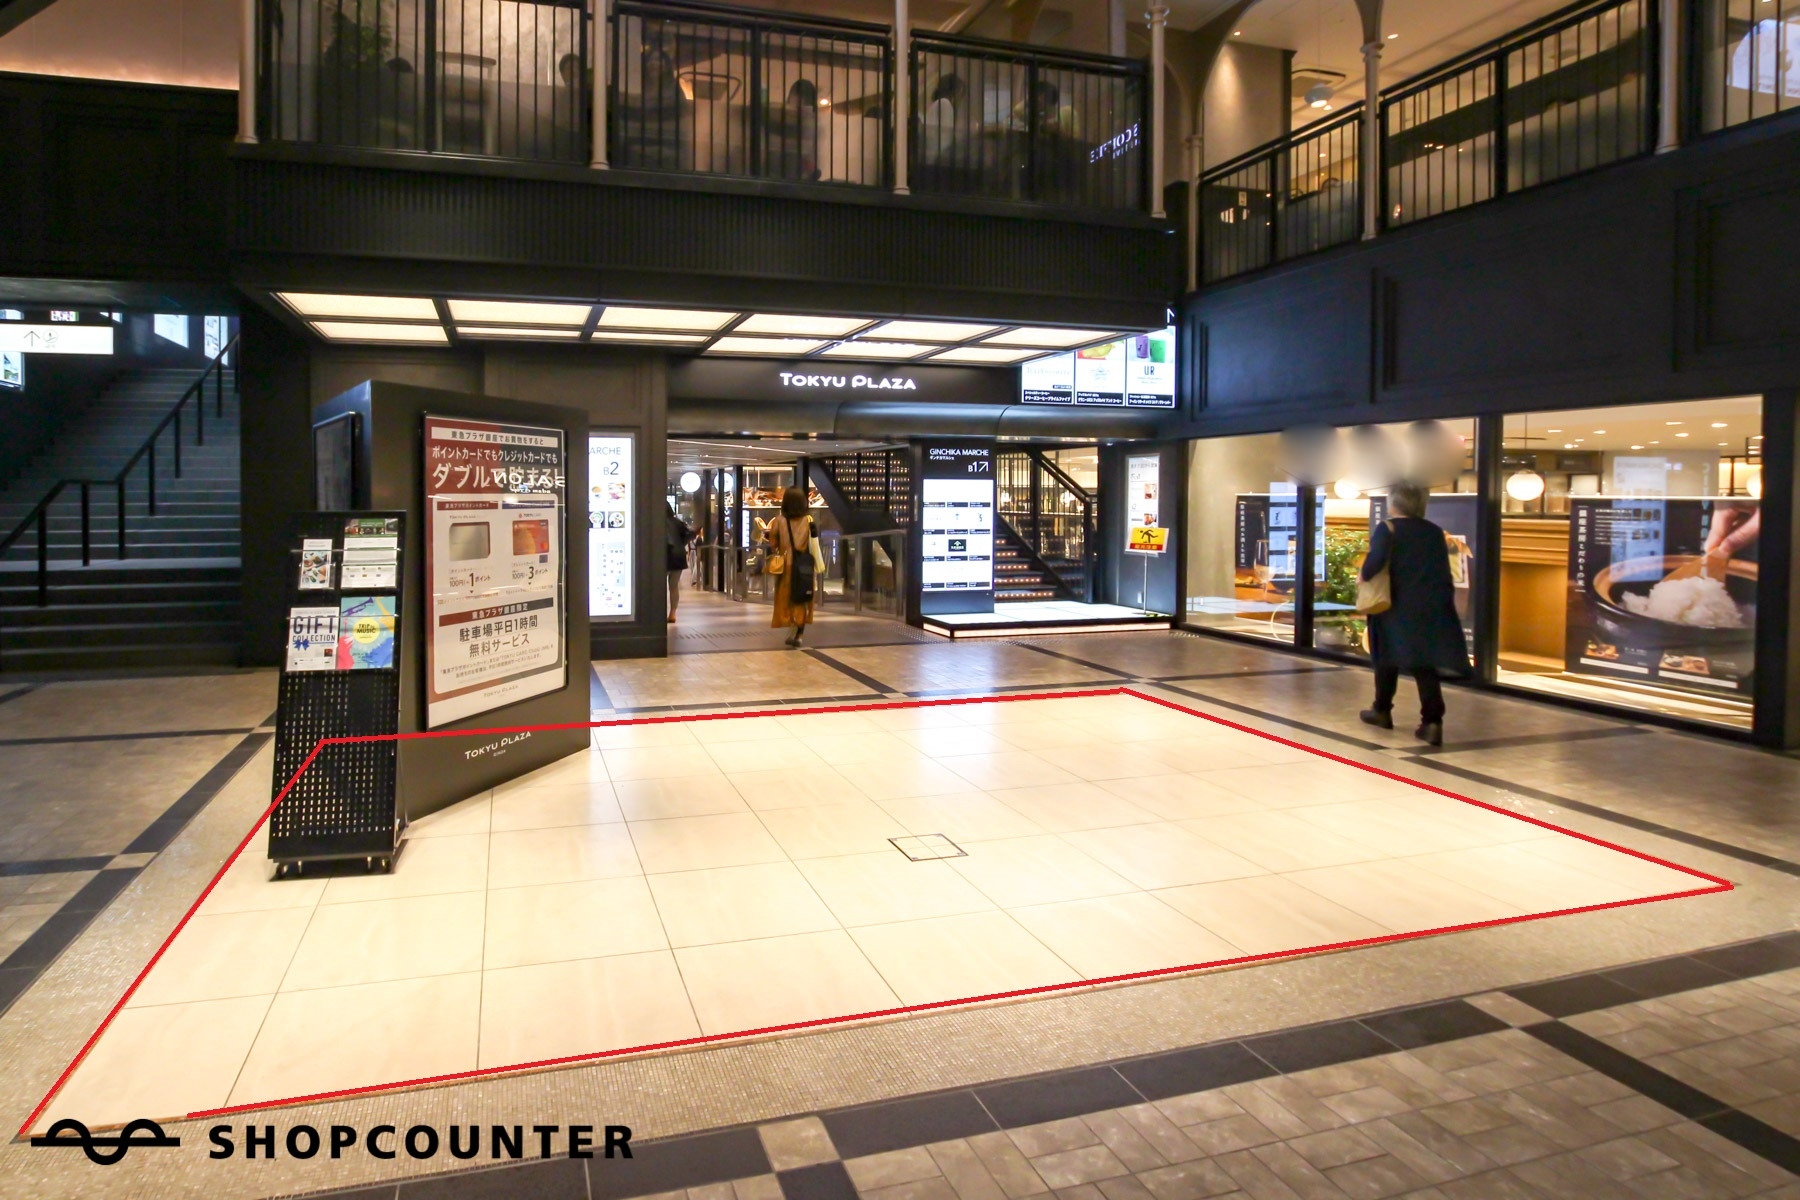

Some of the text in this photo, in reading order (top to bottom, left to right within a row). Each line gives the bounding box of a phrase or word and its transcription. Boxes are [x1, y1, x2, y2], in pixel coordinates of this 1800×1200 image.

[779, 372, 917, 390] TOKYU PLAZA
[432, 445, 558, 463] ポイントカードでもクレジットカードでも
[929, 448, 989, 456] GINCHIKA MARCHE
[603, 461, 620, 476] B2
[967, 461, 977, 473] B1
[293, 615, 336, 635] GIFT
[459, 614, 538, 642] 駐車場平日1時間
[292, 634, 336, 642] COLLECTION
[469, 633, 531, 659] 無料サービス
[483, 684, 519, 699] TOKYU PLAZA
[464, 731, 532, 760] TOKYU PLAZA
